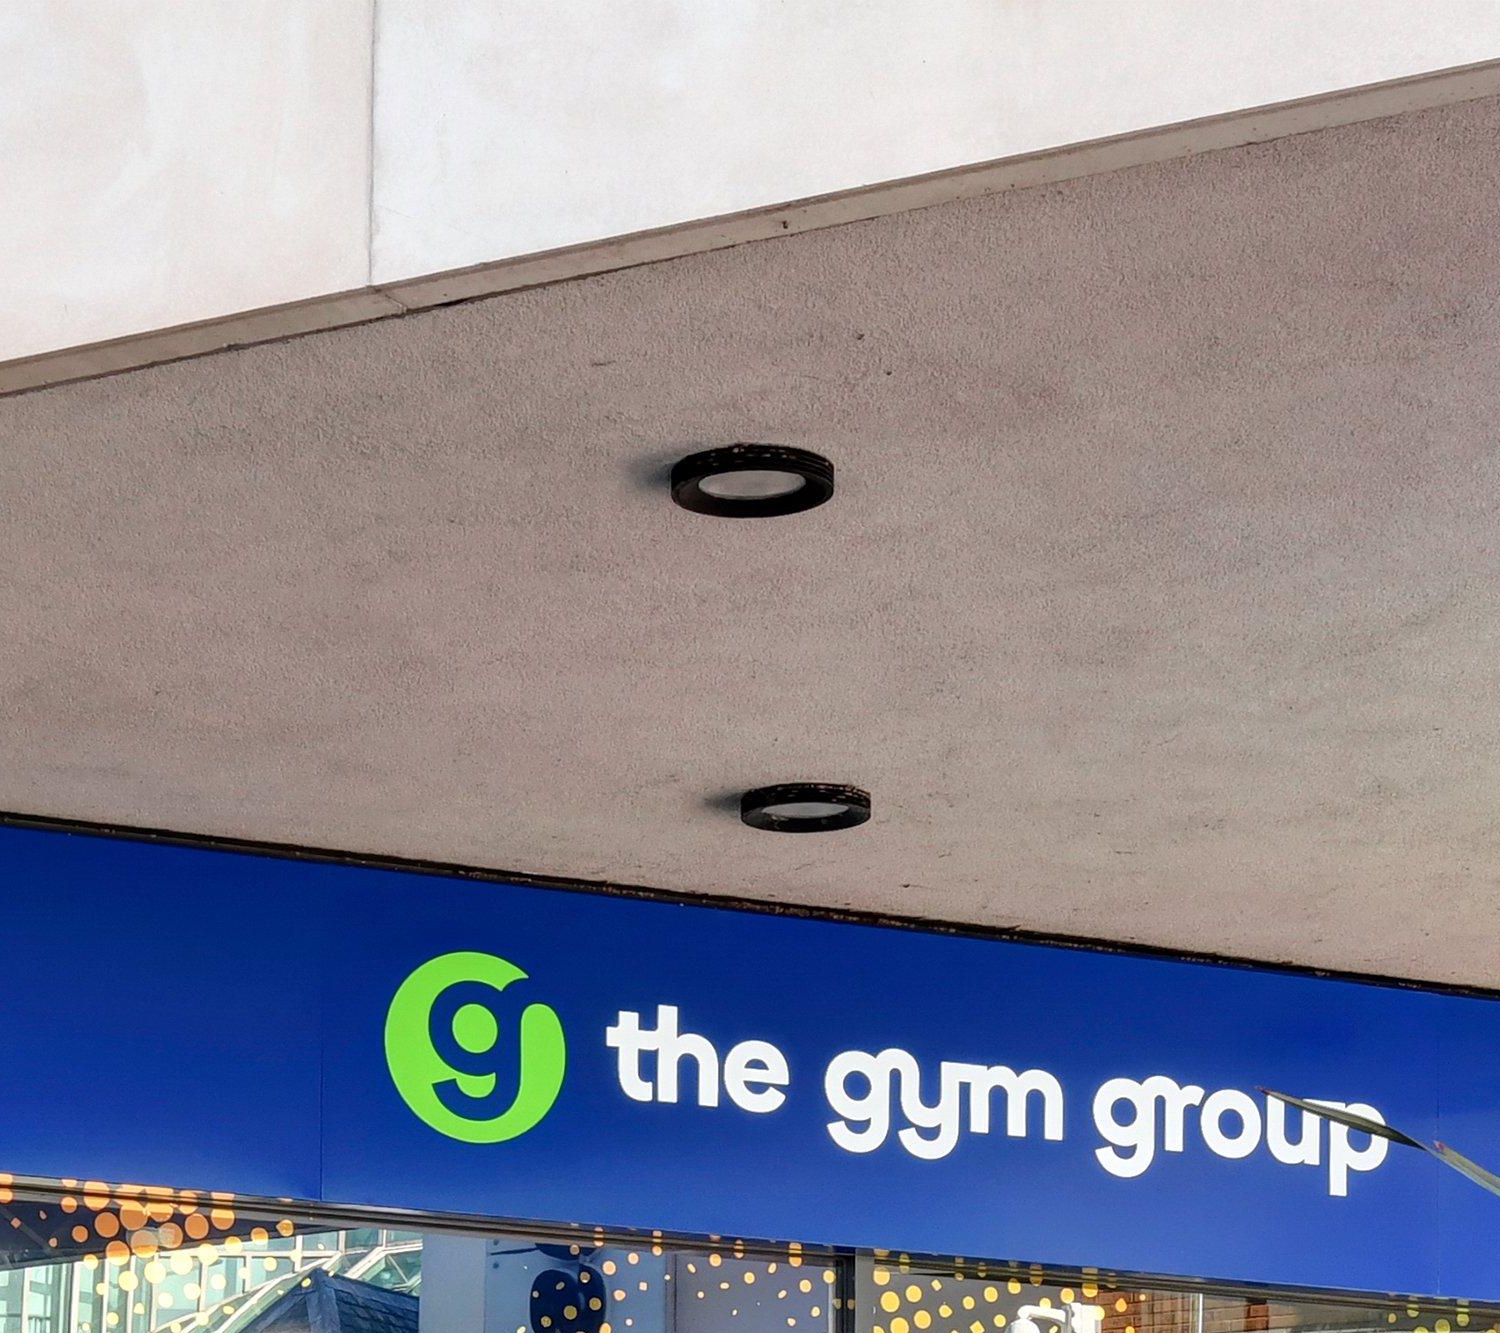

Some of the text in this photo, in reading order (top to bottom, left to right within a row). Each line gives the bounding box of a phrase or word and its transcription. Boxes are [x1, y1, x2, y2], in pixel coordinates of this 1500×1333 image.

[605, 1005, 789, 1114] the
[824, 1047, 1064, 1160] gym
[1091, 1075, 1388, 1197] group
